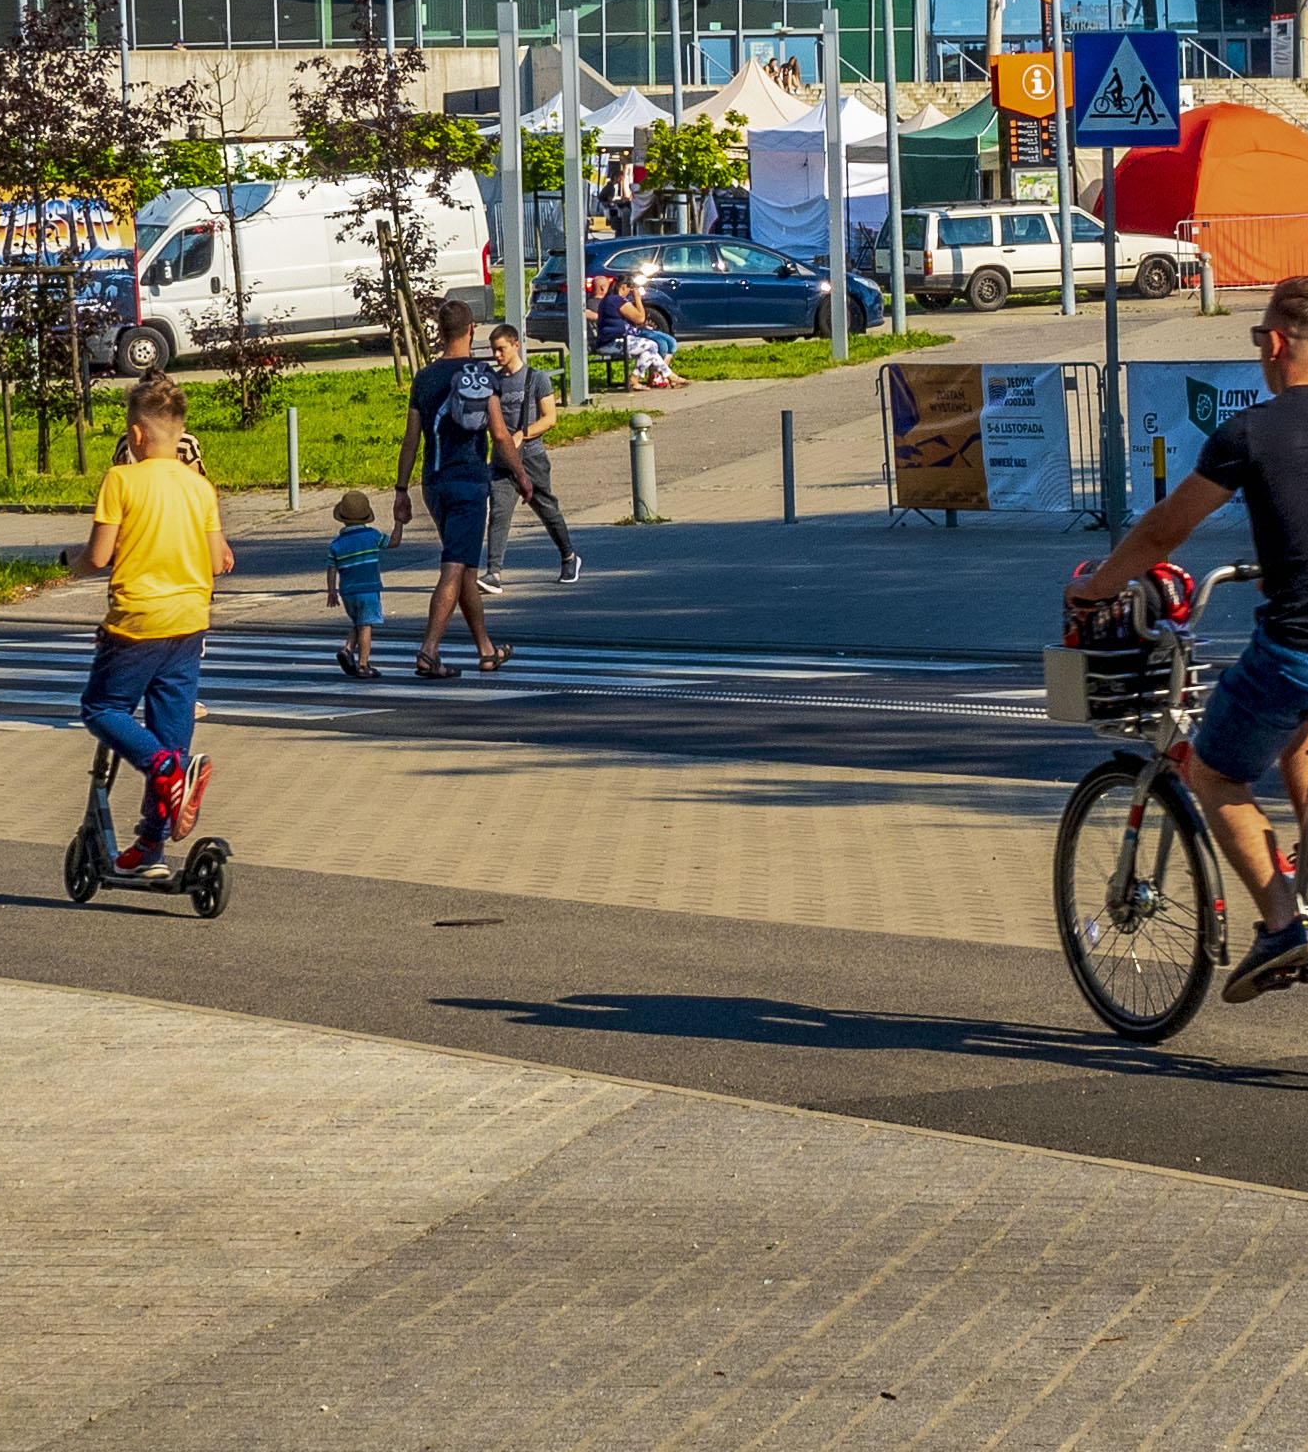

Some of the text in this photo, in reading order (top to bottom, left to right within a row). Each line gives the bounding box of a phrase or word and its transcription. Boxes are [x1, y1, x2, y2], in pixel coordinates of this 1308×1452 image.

[1219, 389, 1260, 407] LOTNY
[987, 423, 1045, 433] 5-6 LISTOPADA
